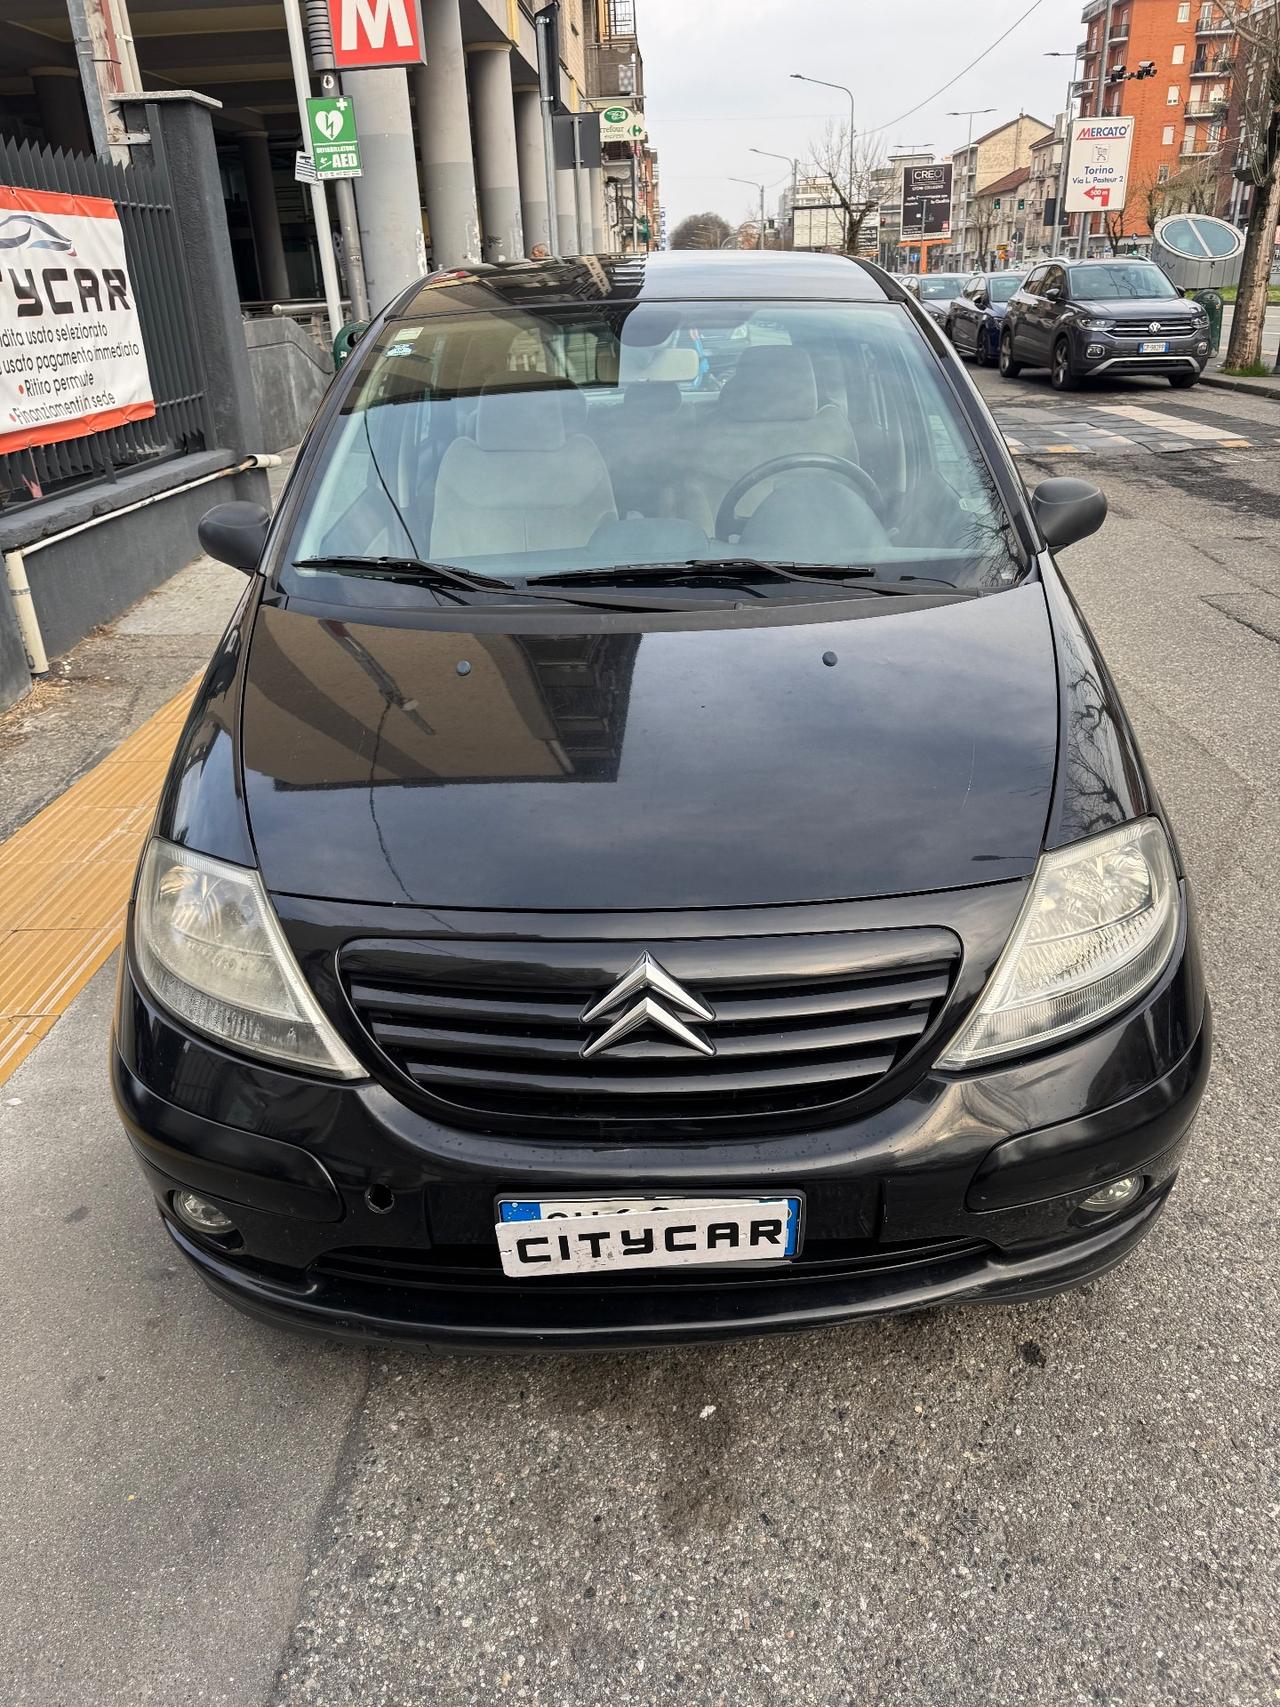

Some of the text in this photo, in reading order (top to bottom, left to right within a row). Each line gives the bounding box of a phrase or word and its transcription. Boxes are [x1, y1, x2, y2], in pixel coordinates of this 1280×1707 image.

[341, 0, 413, 51] M
[332, 152, 358, 168] AED
[1084, 165, 1114, 175] Torino
[914, 169, 942, 179] CREO
[1072, 177, 1084, 185] Via
[1093, 176, 1118, 184] Pasteur
[1119, 175, 1124, 183] 2
[0, 268, 131, 317] YCAR
[25, 325, 54, 346] usato
[55, 321, 109, 342] selezionato
[3, 340, 140, 374] usato pagamento immediato
[24, 370, 94, 397] Ritiro permute
[92, 390, 116, 408] sede
[516, 1219, 783, 1264] CITYCAR
